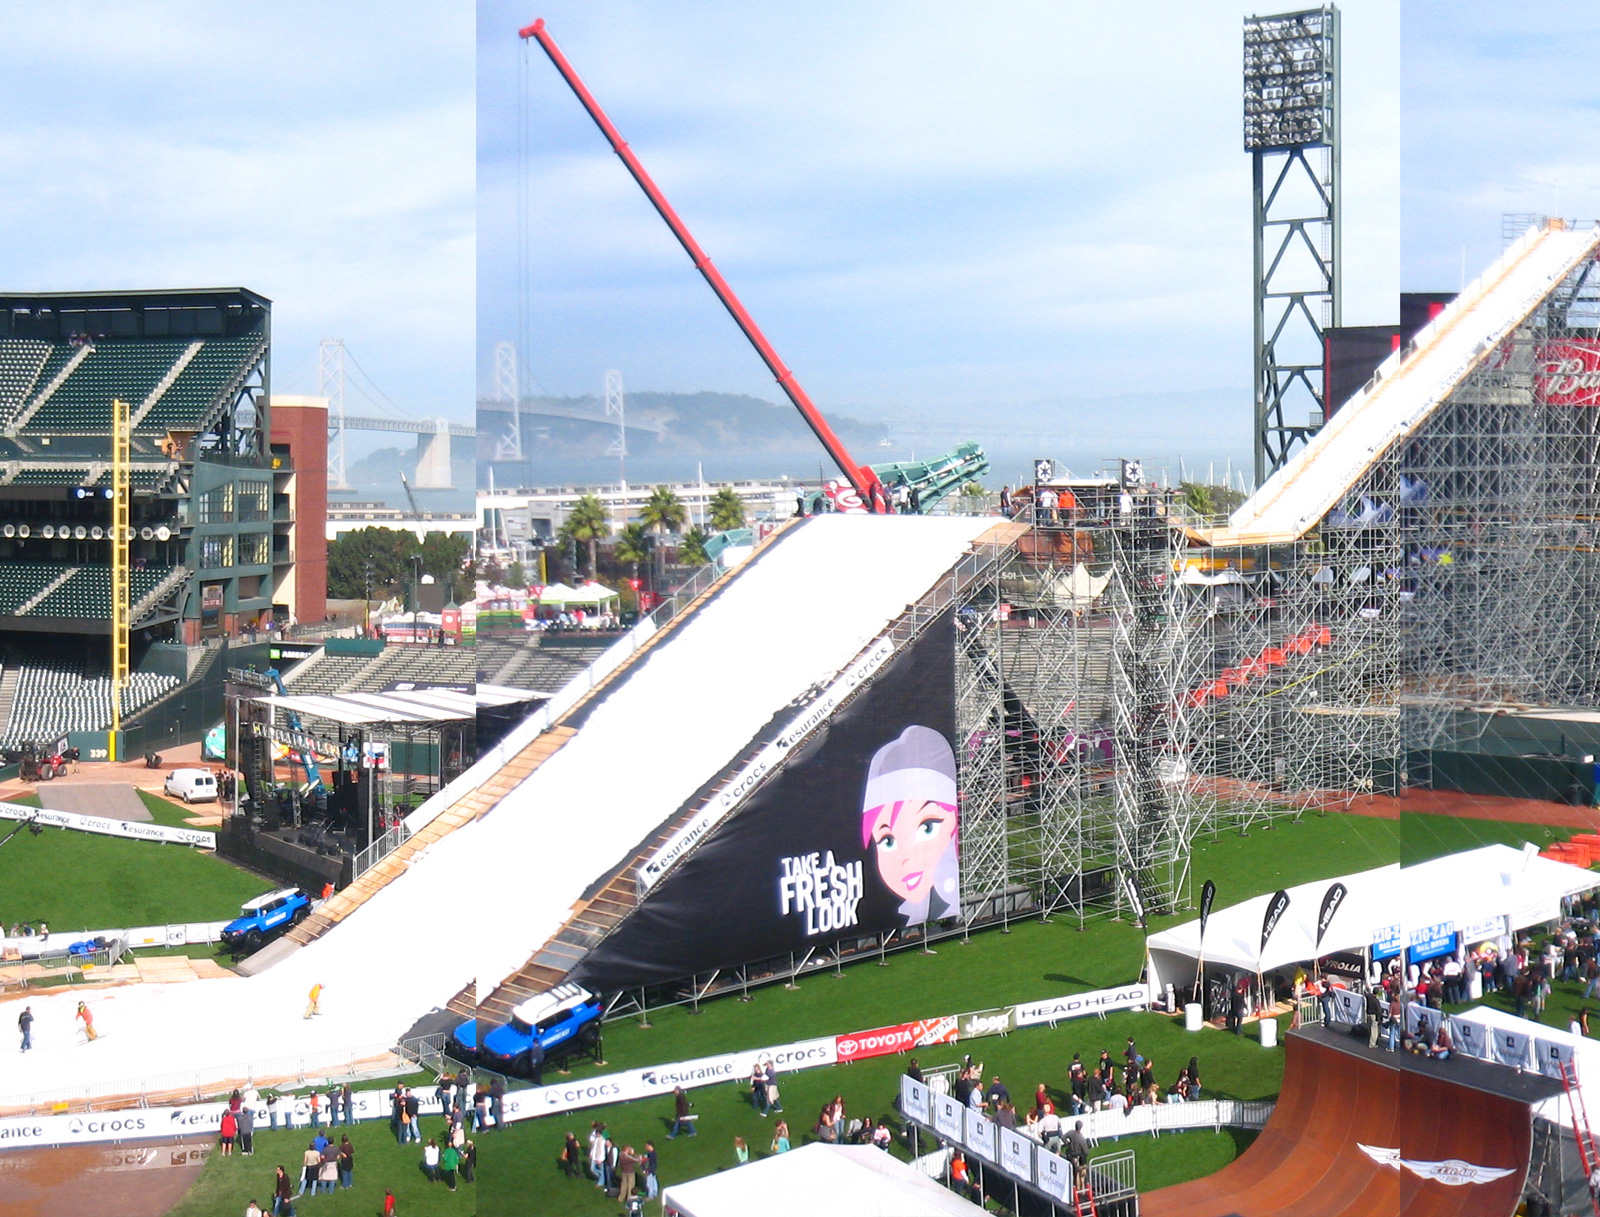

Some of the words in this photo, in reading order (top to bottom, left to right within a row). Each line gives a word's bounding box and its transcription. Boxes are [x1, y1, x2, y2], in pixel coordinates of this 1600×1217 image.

[857, 647, 888, 679] crocs
[788, 697, 835, 743] esurance
[90, 749, 108, 758] 339
[733, 762, 767, 797] crocs
[128, 825, 164, 838] esurance
[659, 818, 709, 868] esurance
[781, 851, 820, 879] TAKE
[780, 860, 863, 915] FRESH
[807, 897, 861, 935] LOOK
[1263, 896, 1286, 938] HEAD
[1320, 887, 1342, 930] HEAD
[1022, 1001, 1082, 1018] HEAD
[1086, 990, 1143, 1007] HEAD
[966, 1014, 1009, 1031] Jeep
[859, 1031, 913, 1051] TOYOTA
[775, 1047, 827, 1064] crocs
[660, 1063, 733, 1085] esurance
[565, 1082, 620, 1102] crocs
[88, 1117, 145, 1133] crocs
